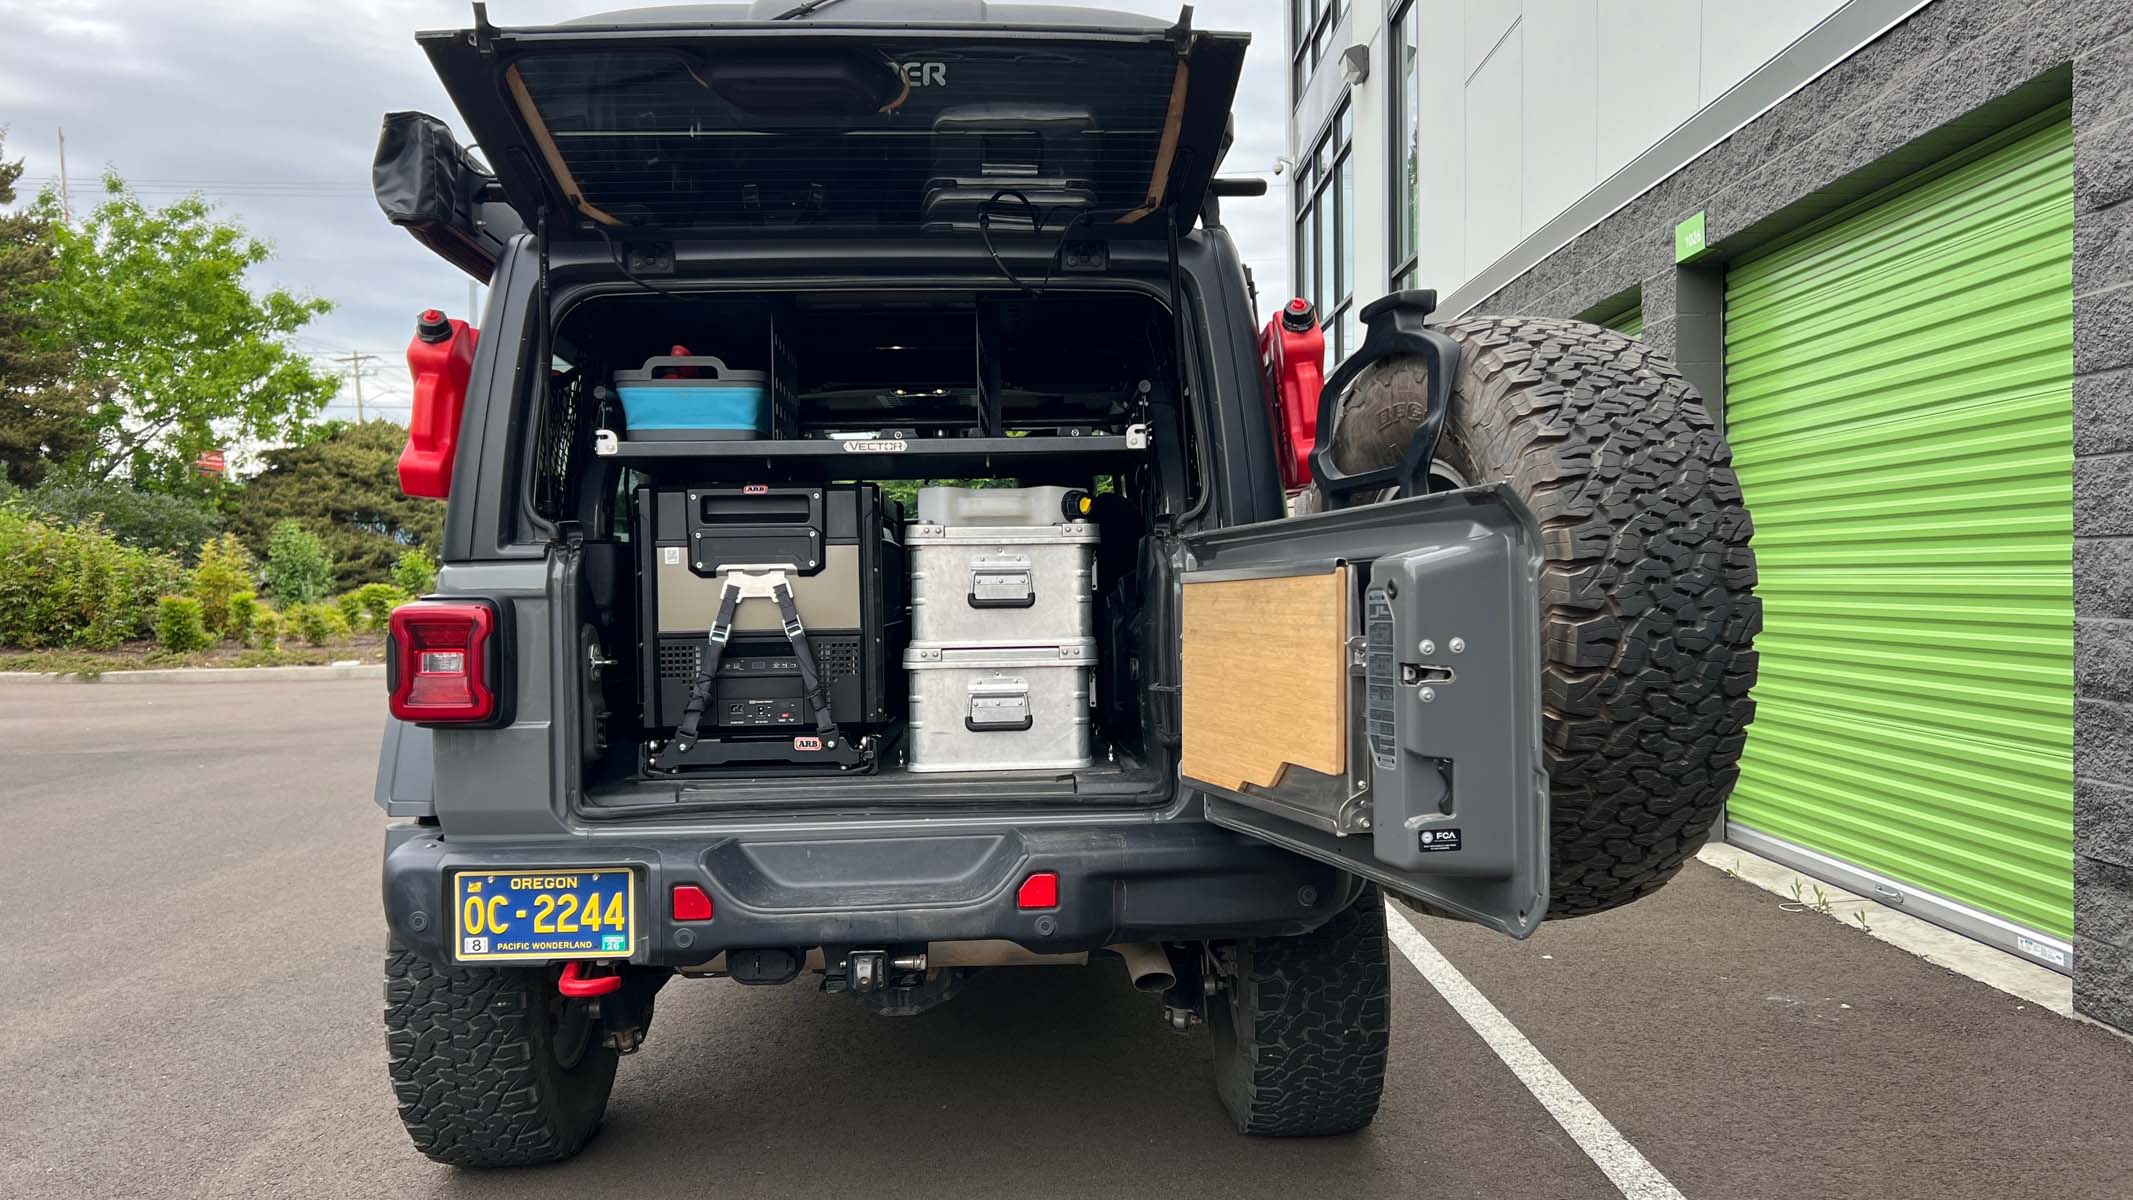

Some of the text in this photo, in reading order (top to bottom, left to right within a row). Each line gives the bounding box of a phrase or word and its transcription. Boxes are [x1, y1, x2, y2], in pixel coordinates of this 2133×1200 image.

[849, 441, 903, 451] VECTOR
[798, 740, 818, 748] ARB
[510, 876, 579, 890] OREGON
[472, 939, 481, 951] 8
[497, 941, 593, 951] PACIFIC WONDERLAND
